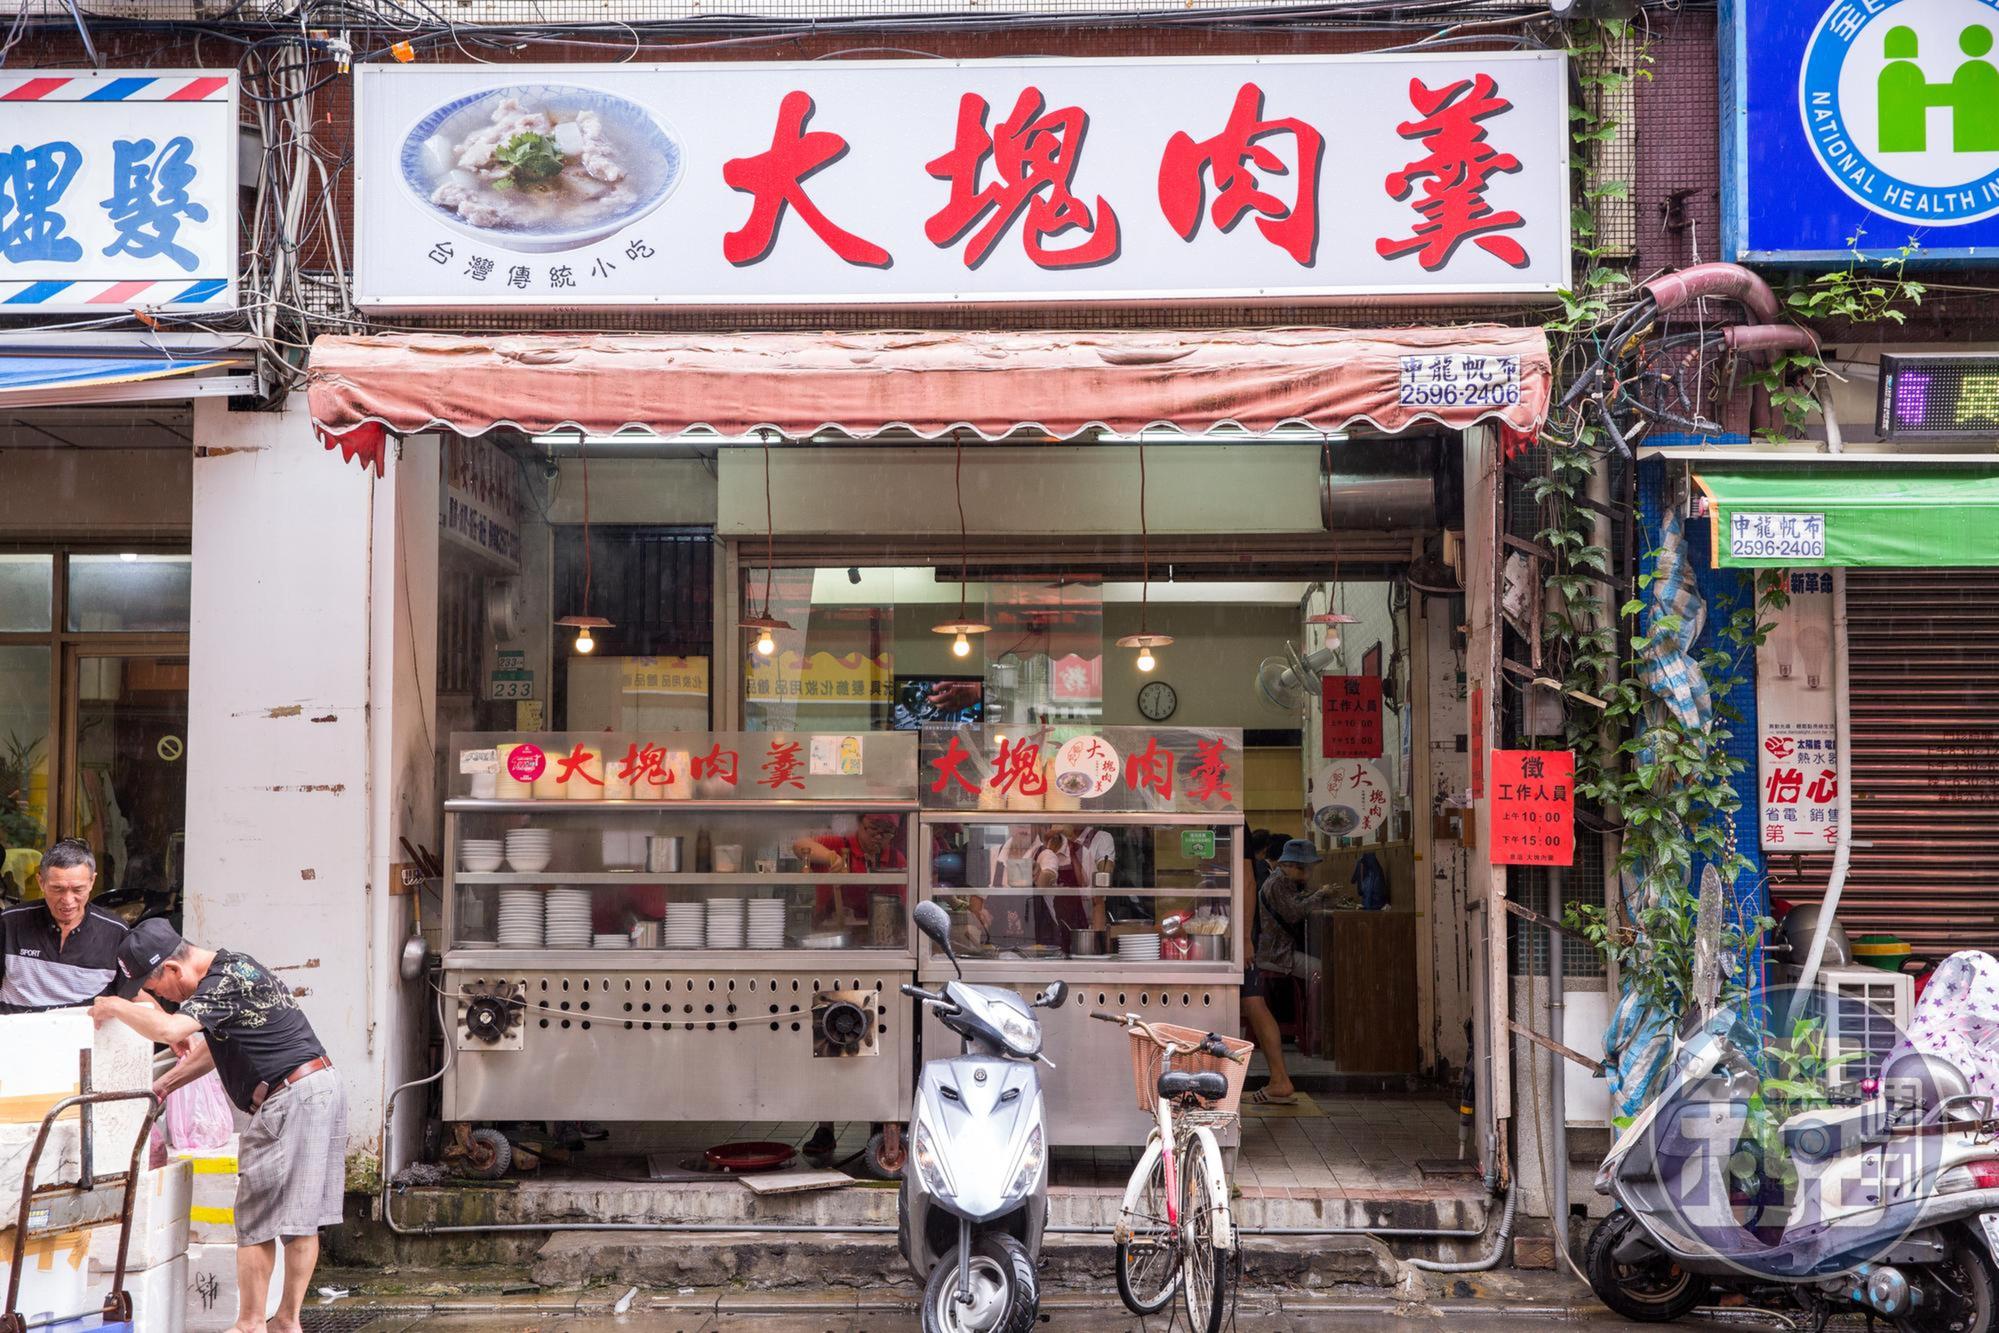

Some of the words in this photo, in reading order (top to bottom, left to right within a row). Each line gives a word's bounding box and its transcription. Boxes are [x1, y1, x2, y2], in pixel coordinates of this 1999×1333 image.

[1812, 91, 1876, 194] NATIONAL
[1883, 184, 1976, 213] HEALTH
[723, 73, 1531, 270] 大塊肉羹
[428, 238, 656, 289] 台灣傳統小吃
[1733, 515, 1823, 539] 申龍帆布
[494, 683, 531, 697] 233
[557, 741, 806, 789] 大塊肉羹
[931, 735, 1233, 801] 大塊肉羹
[1521, 756, 1544, 779] 徵
[1498, 784, 1567, 801] 工作人員
[1765, 768, 1838, 804] 怡心
[1766, 807, 1797, 822] 省電
[1766, 824, 1838, 844] 第一名
[20, 949, 41, 957] SPORT
